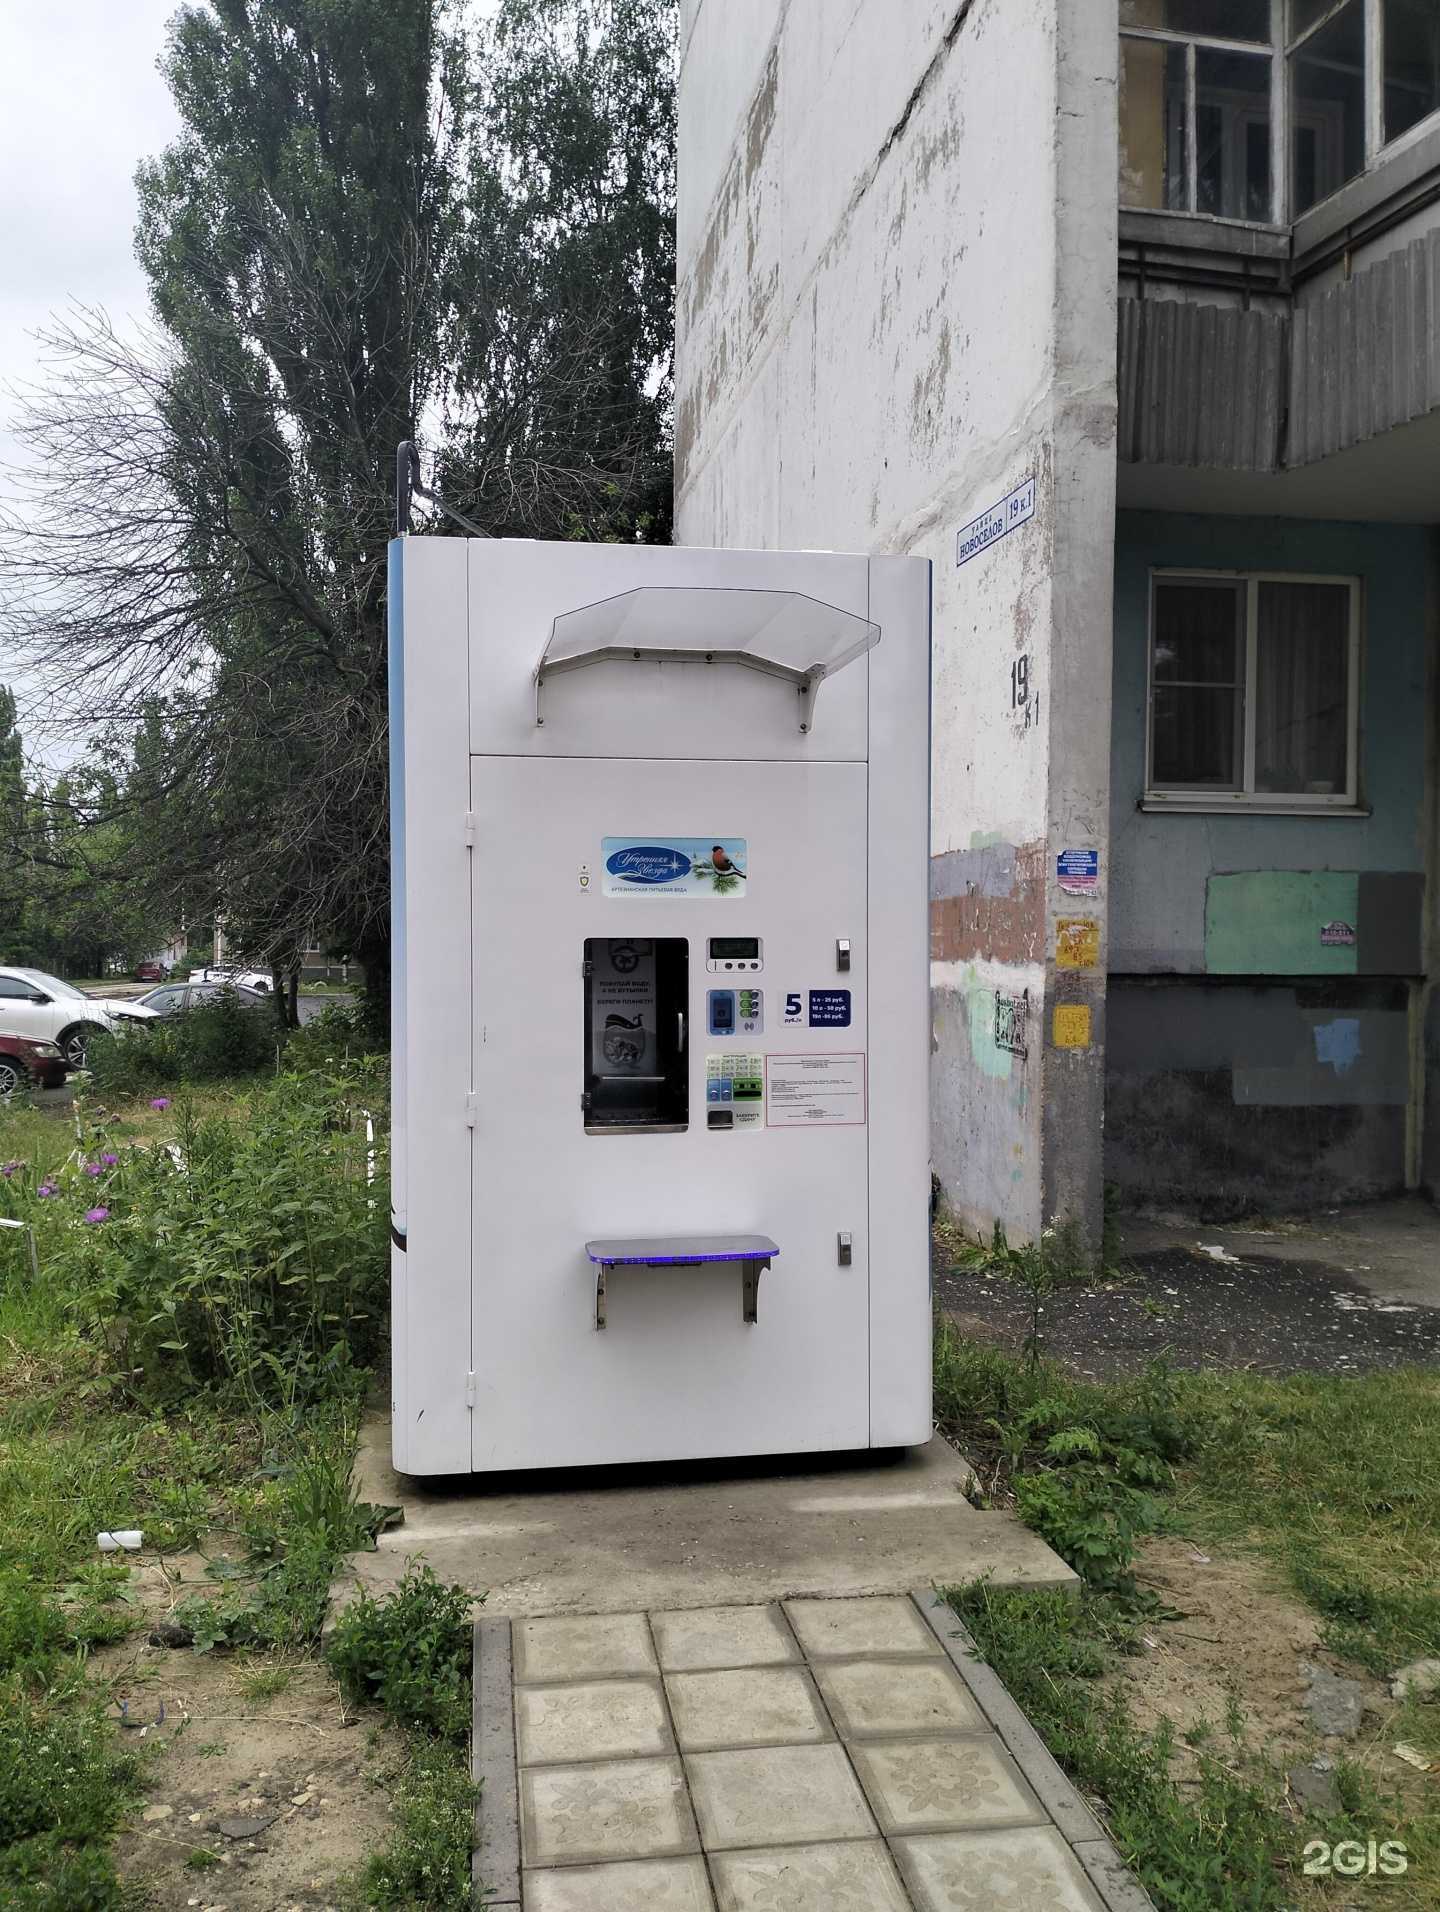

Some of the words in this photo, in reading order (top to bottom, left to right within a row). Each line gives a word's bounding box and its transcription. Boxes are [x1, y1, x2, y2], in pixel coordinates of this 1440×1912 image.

[1010, 499, 1019, 520] 19
[971, 514, 992, 535] УЛИЦА
[960, 518, 1003, 559] НОВОСЕЛОВ
[1011, 654, 1028, 709] 19
[785, 994, 802, 1015] 5
